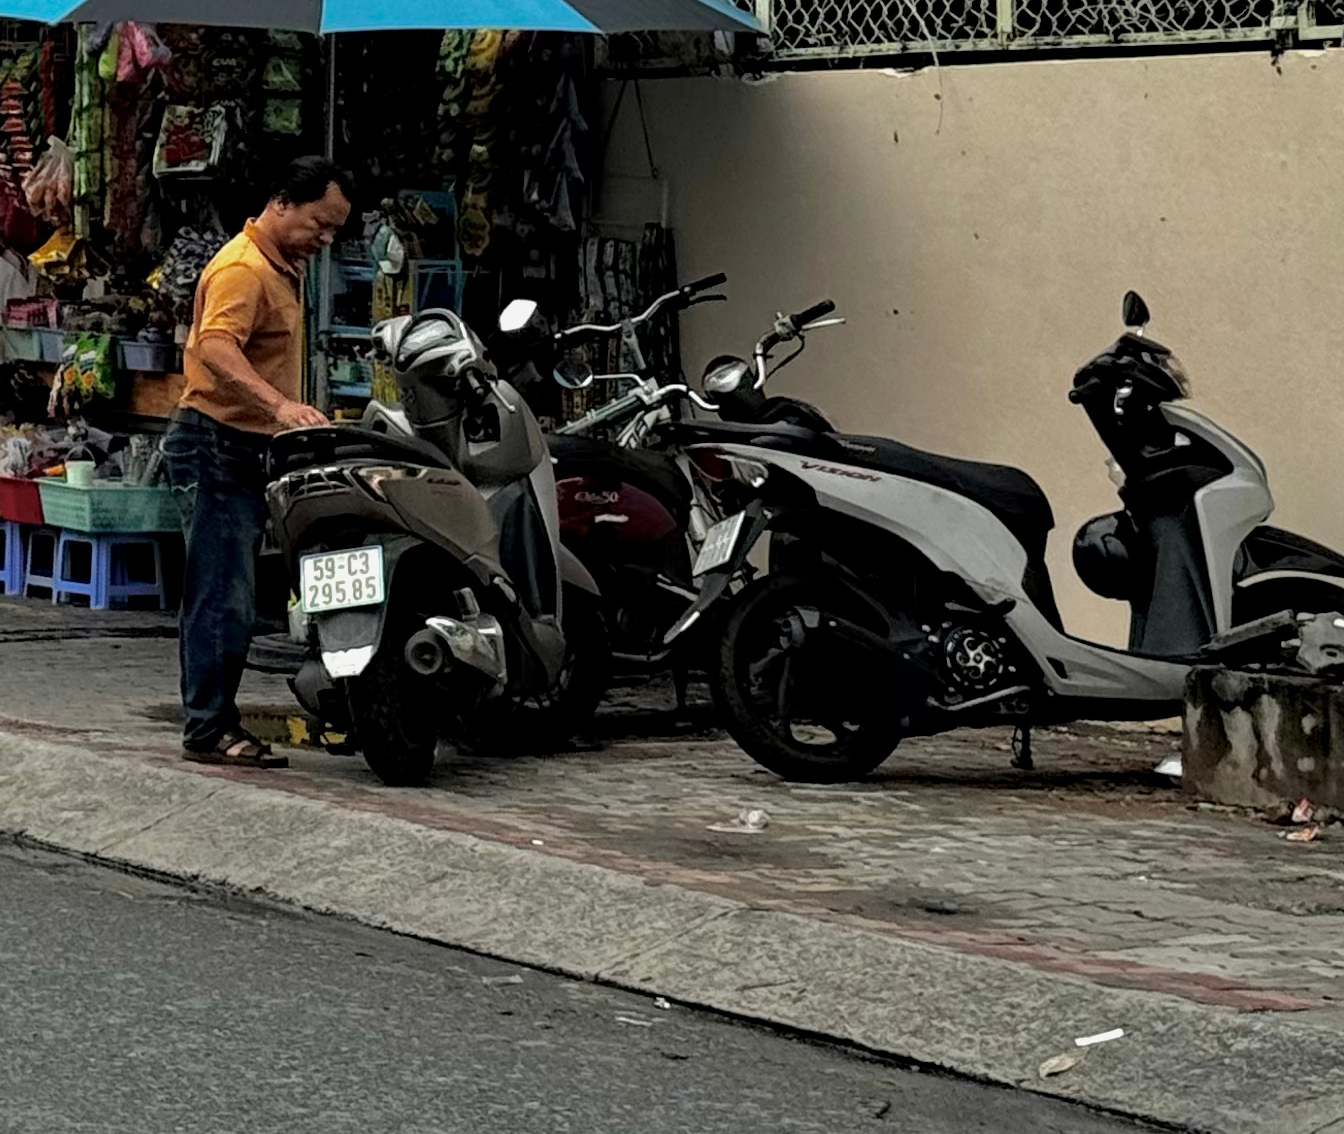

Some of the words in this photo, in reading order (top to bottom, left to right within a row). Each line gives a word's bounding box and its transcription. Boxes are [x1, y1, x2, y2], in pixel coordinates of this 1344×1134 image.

[800, 460, 882, 483] VISION
[313, 552, 371, 582] 59-C3
[309, 576, 377, 609] 295.85
